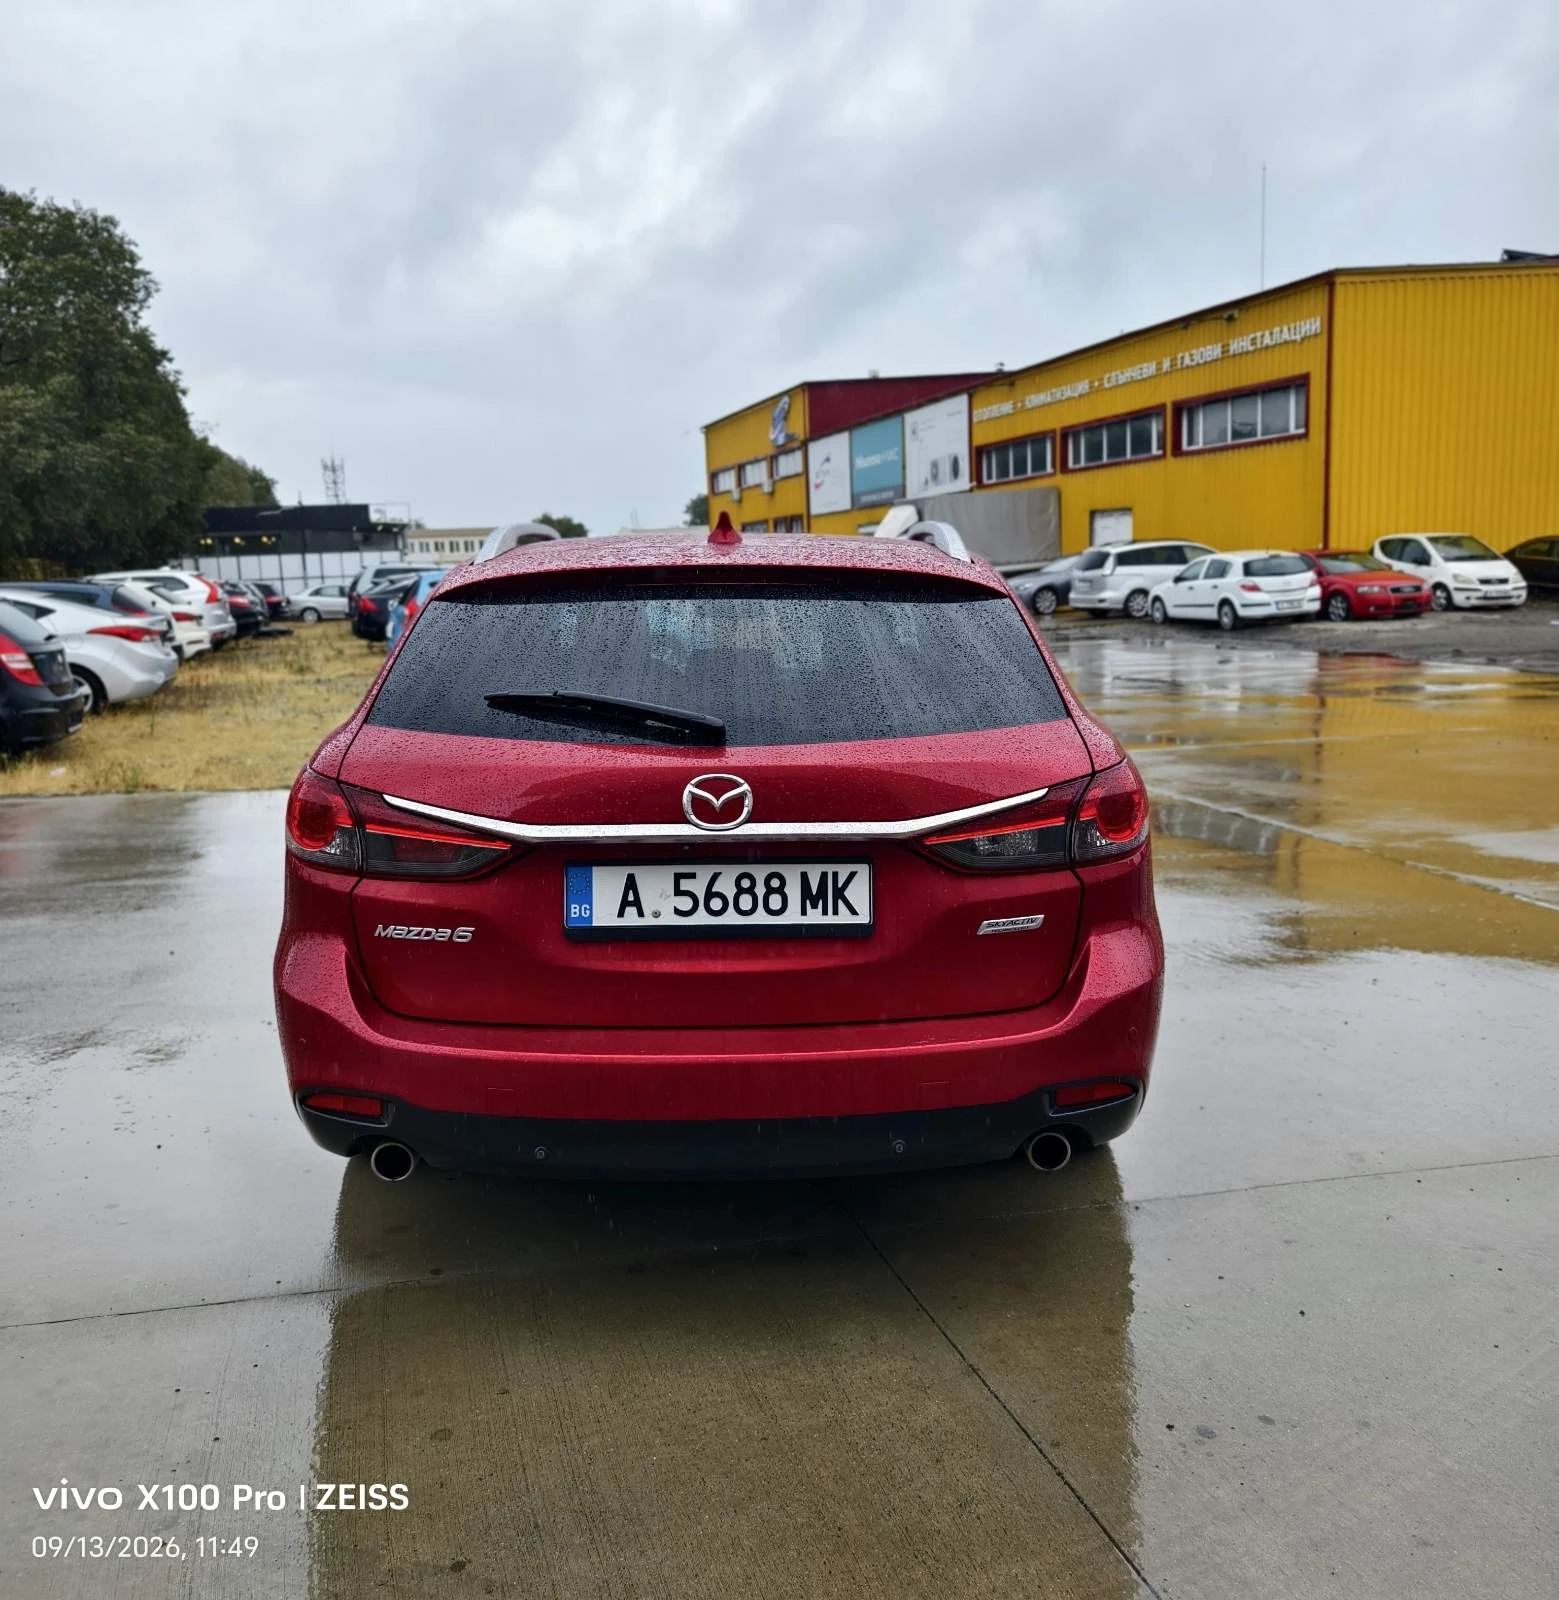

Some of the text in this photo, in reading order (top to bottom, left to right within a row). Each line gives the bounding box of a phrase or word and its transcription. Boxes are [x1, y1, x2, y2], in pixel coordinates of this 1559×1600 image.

[1163, 357, 1171, 373] И
[1177, 342, 1222, 369] ГАЗОВИ
[1229, 316, 1322, 356] ИНСТАЛАЦИИ
[570, 903, 591, 918] BG
[616, 870, 860, 919] A 5688 MK
[986, 917, 1040, 929] SKYACTIV
